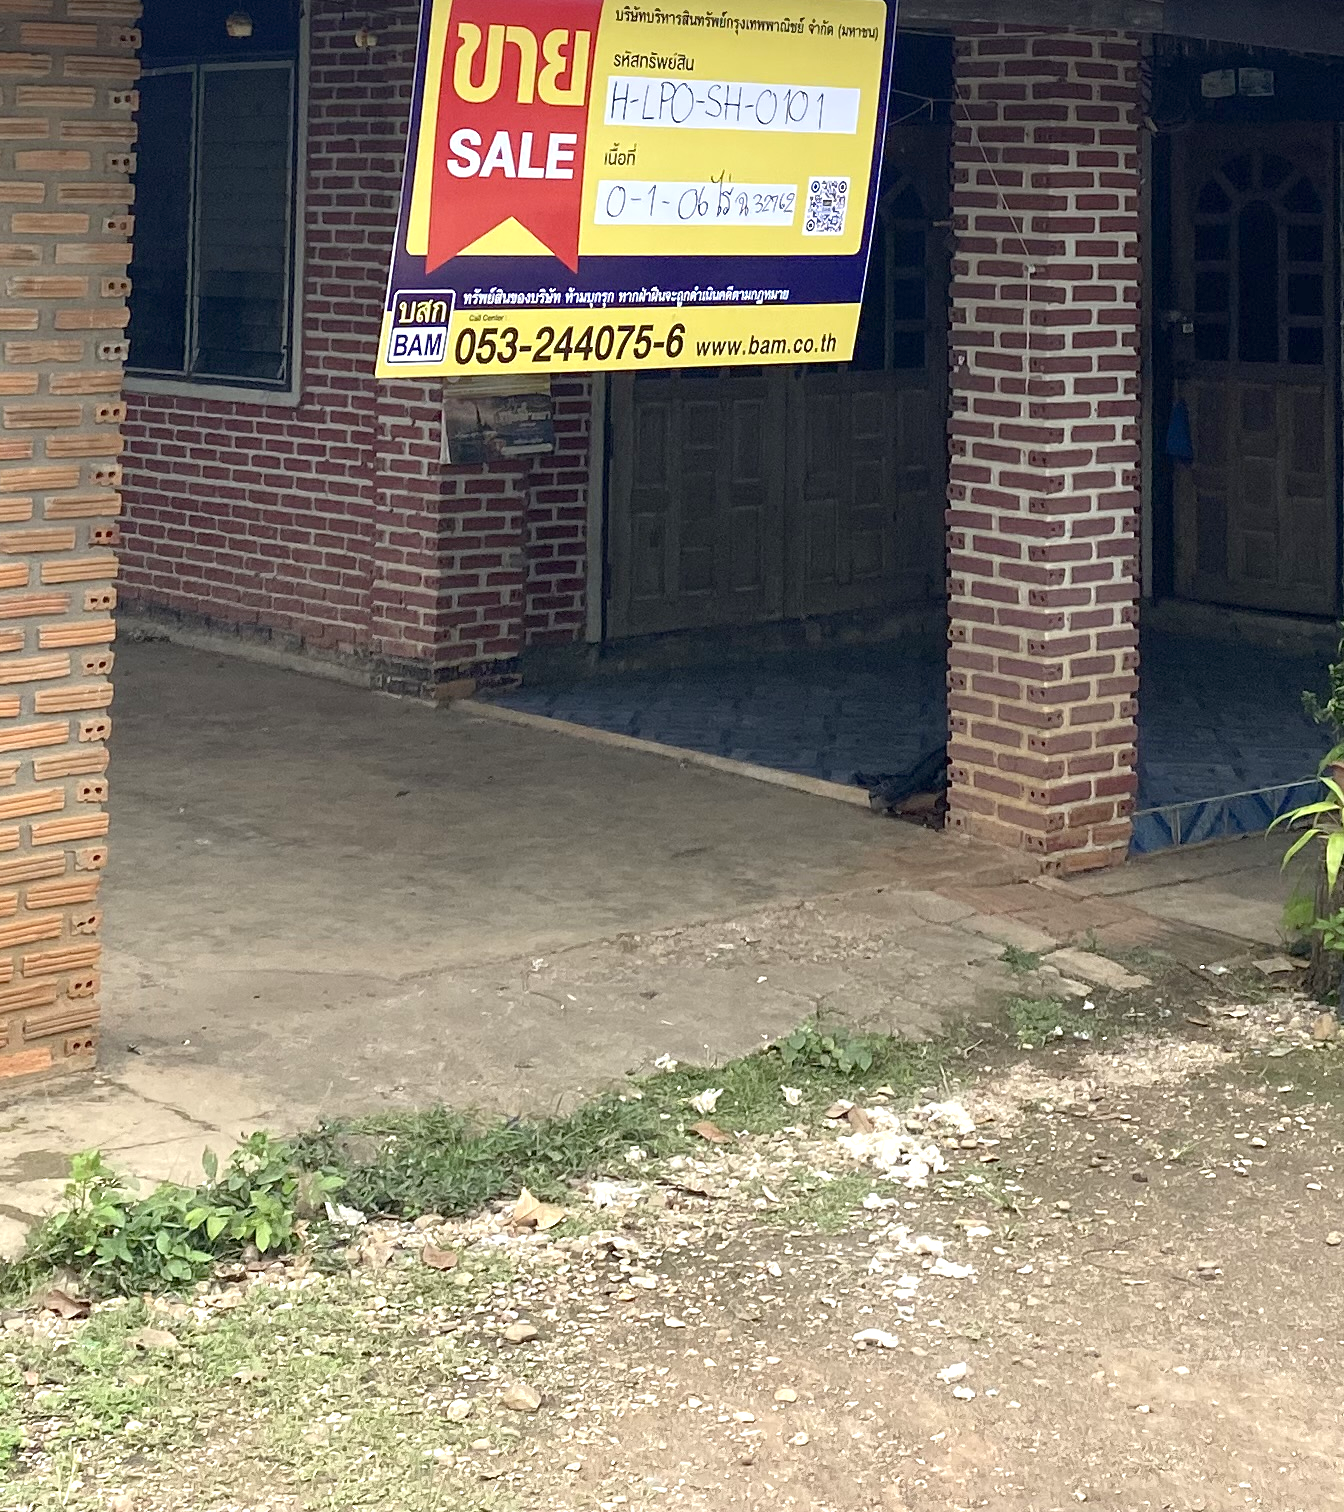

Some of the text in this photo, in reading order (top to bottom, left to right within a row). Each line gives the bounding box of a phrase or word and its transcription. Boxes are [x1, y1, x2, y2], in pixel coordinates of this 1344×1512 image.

[615, 5, 879, 41] บริษัทบริหารสินทรัพย์กรุงเทพพาณิชย์ จำกัด (มหาชน)
[453, 22, 591, 107] ขาย
[613, 51, 695, 71] รหัสทรัพย์สิน
[446, 128, 578, 179] SALE
[604, 142, 637, 166] เนื้อที่
[463, 287, 561, 305] ทรัพย์สินของบริษัท
[565, 287, 615, 309] ห้ามบุกรุก
[398, 299, 447, 324] บสก
[469, 314, 482, 322] Call
[393, 333, 443, 357] BAM
[455, 323, 686, 365] 053-244075-6
[696, 333, 837, 357] www.bam.co.th
